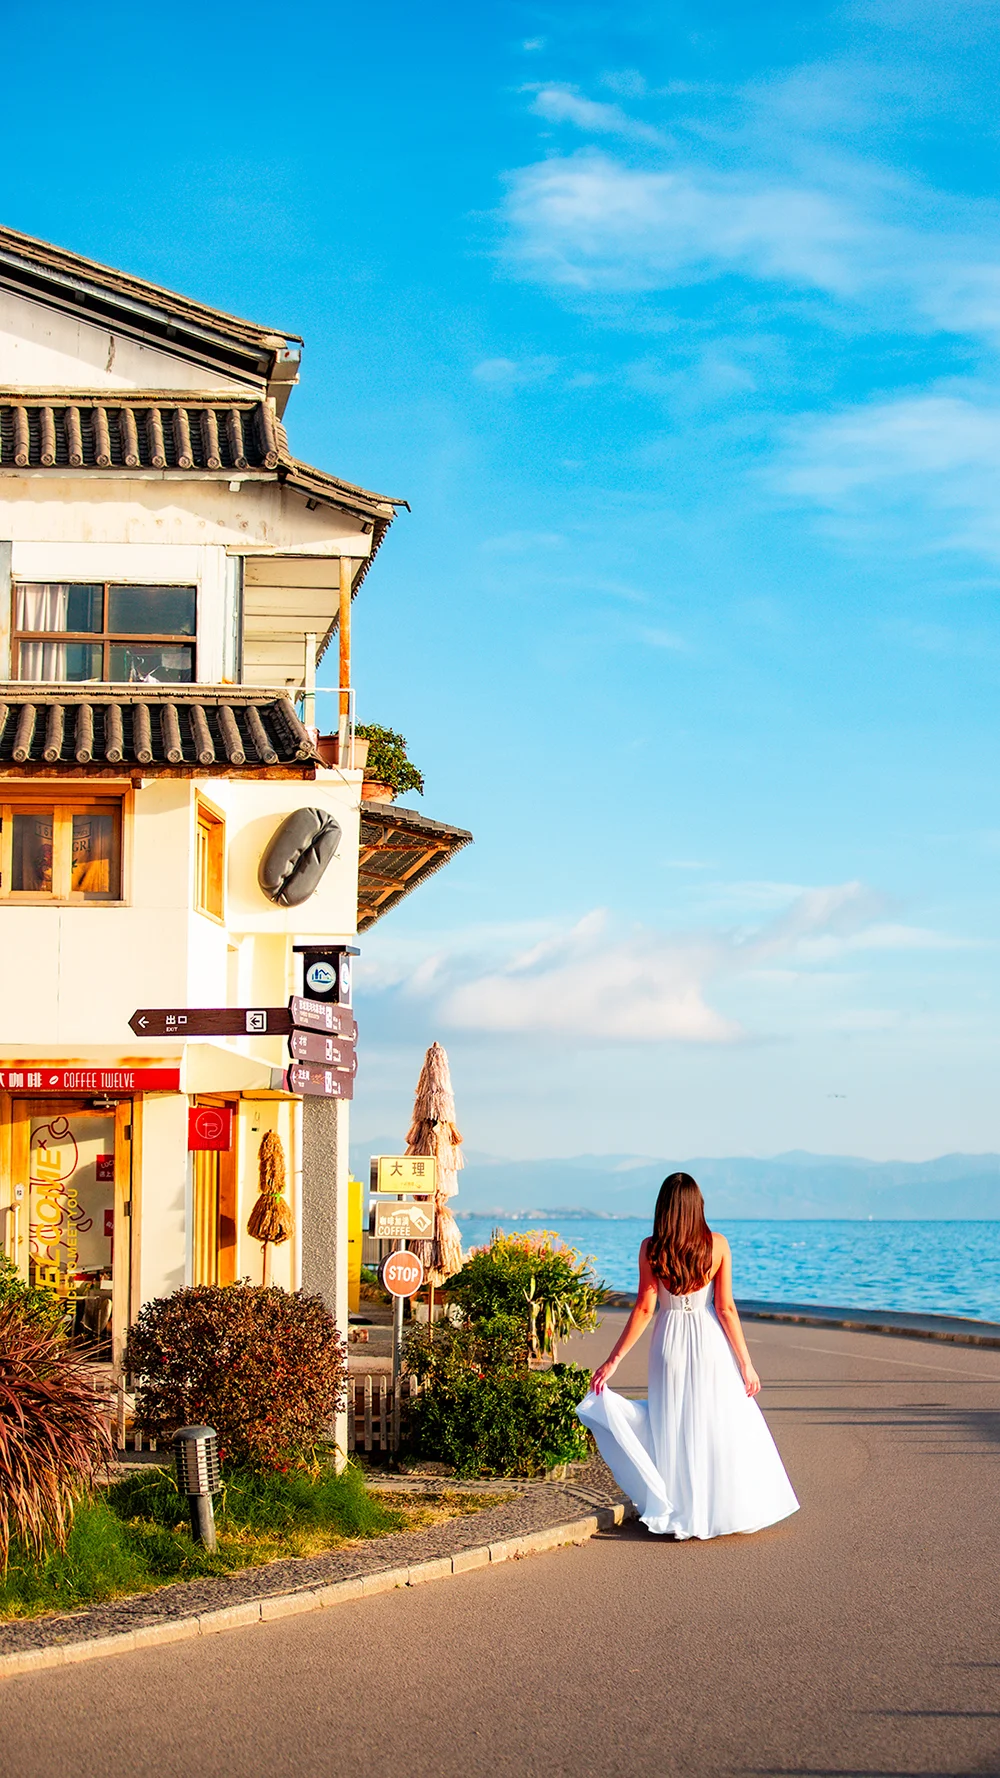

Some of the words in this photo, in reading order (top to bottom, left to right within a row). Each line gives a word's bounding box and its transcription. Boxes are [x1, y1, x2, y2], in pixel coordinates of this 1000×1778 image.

[165, 1014, 188, 1025] 出口
[63, 1072, 97, 1088] COFFEE
[101, 1072, 135, 1088] TWELVE
[390, 1160, 425, 1177] 大理
[67, 1188, 78, 1218] YOU
[67, 1220, 78, 1258] MEET
[378, 1226, 410, 1237] COFFEE
[67, 1261, 78, 1280] TO
[388, 1265, 419, 1282] STOP
[67, 1282, 78, 1315] NICE
